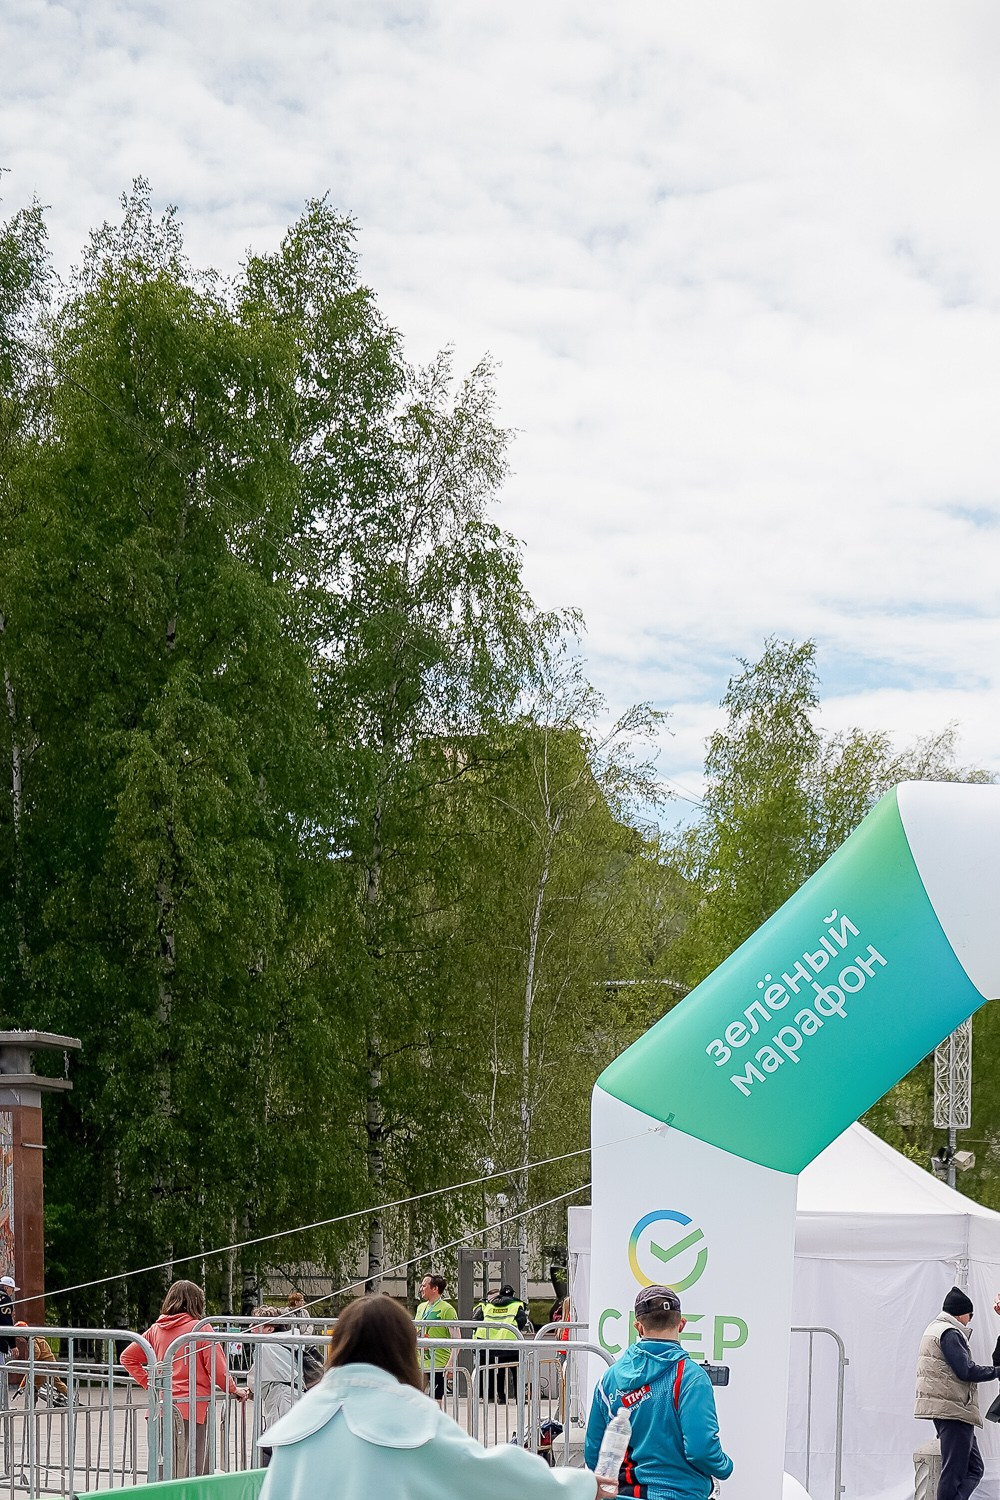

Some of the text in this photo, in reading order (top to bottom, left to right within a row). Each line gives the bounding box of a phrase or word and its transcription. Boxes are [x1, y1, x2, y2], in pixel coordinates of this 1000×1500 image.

[705, 908, 861, 1067] зелёный
[729, 944, 888, 1098] марафон
[598, 1309, 748, 1361] СЕР
[625, 1386, 647, 1405] TIME
